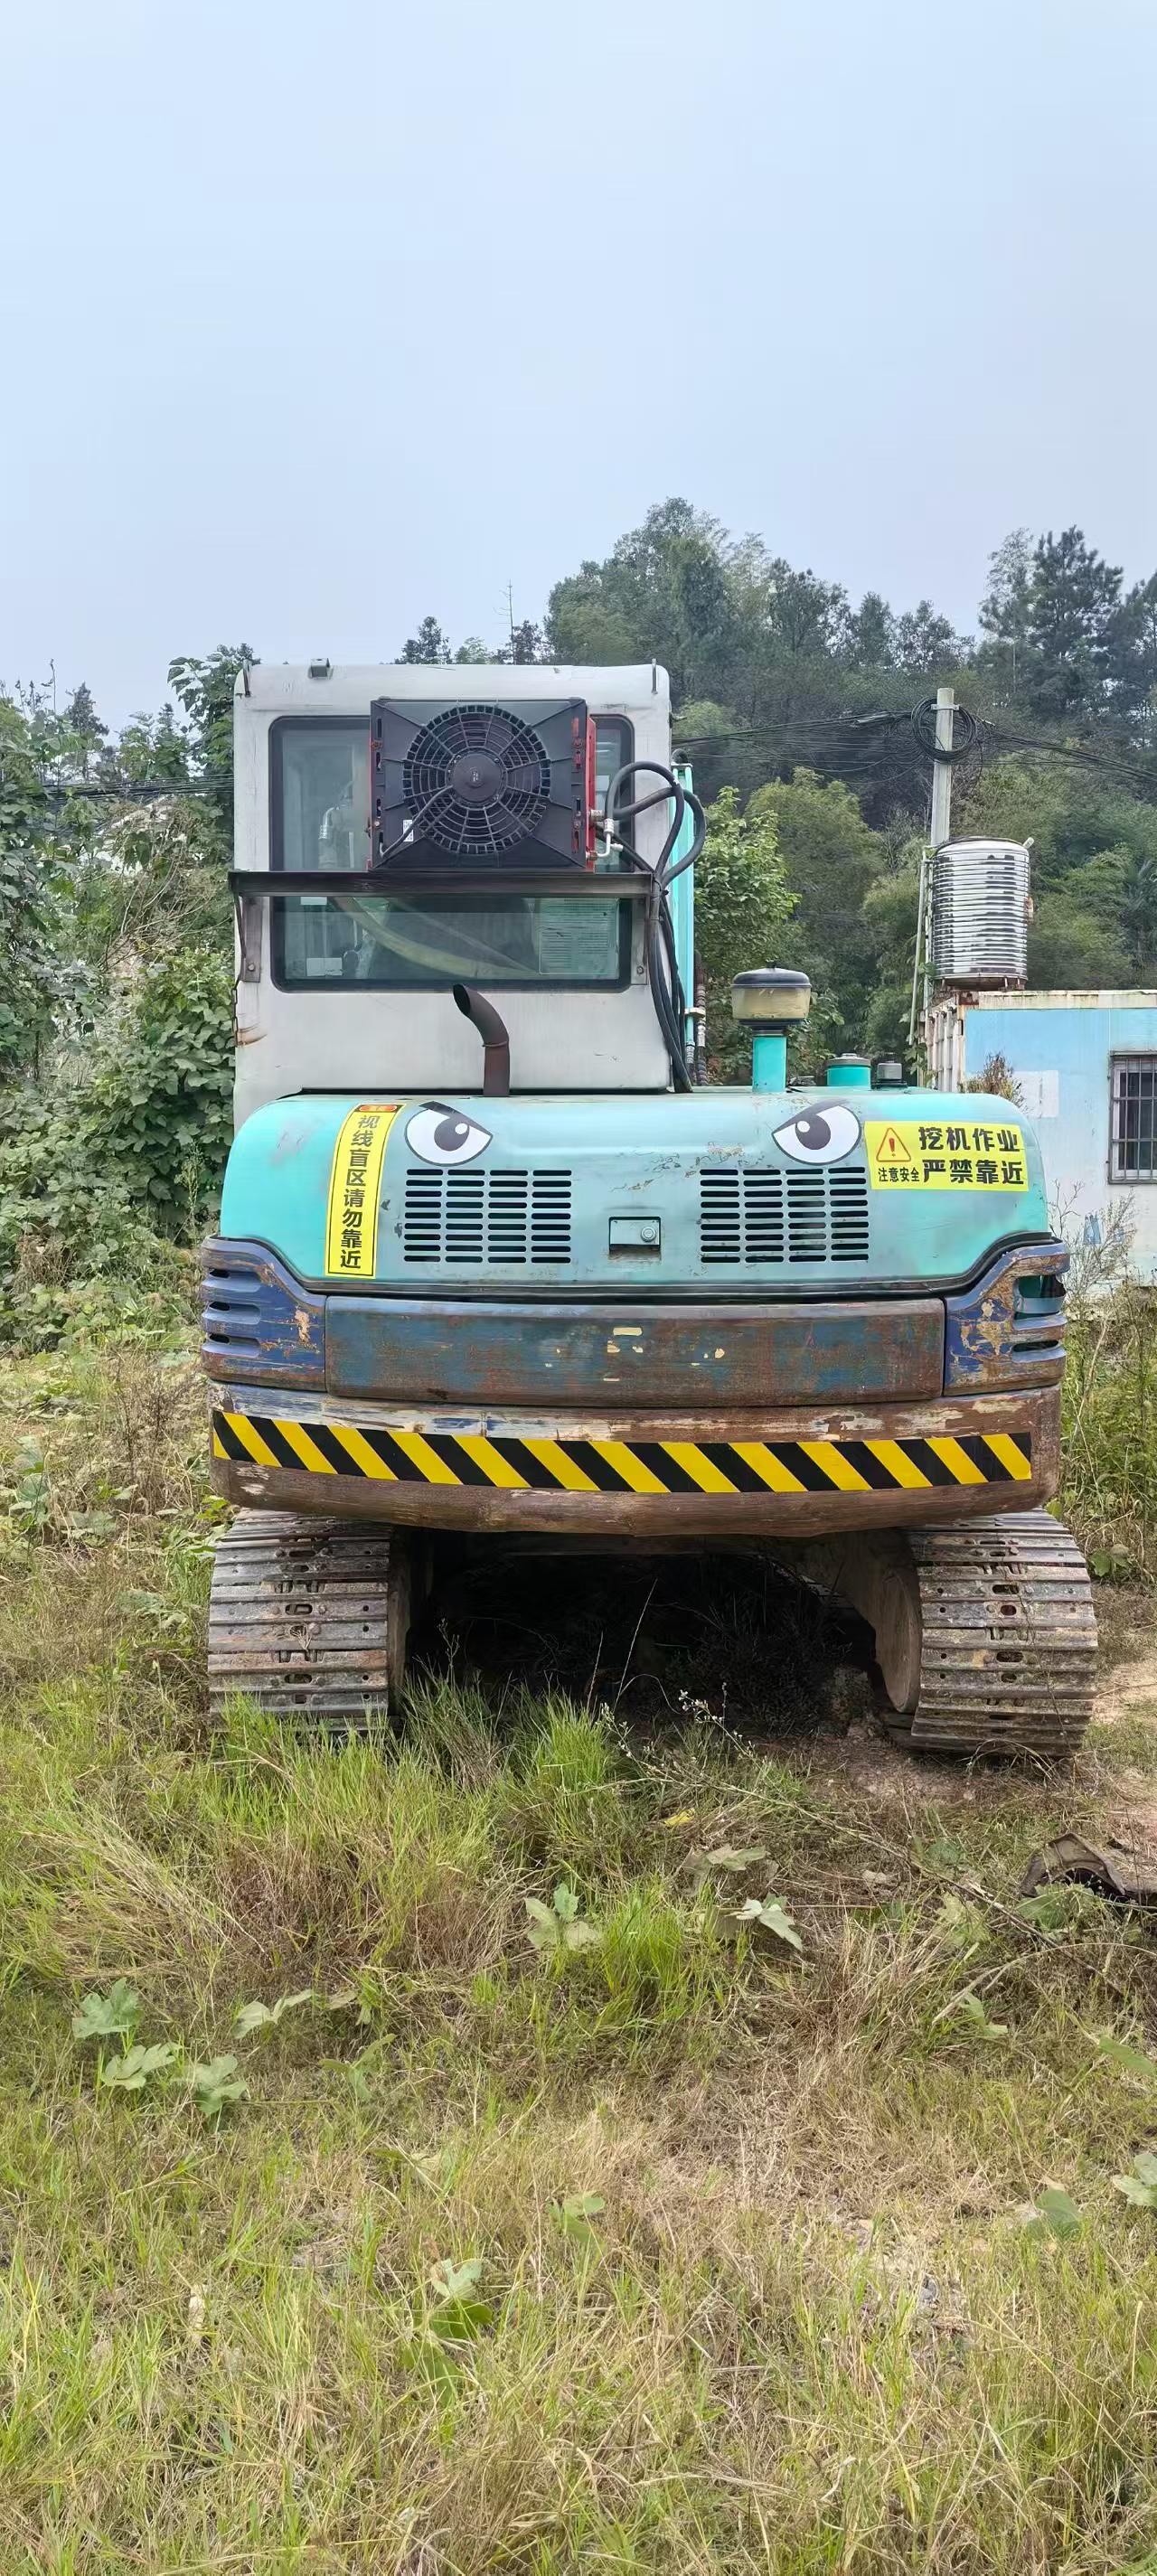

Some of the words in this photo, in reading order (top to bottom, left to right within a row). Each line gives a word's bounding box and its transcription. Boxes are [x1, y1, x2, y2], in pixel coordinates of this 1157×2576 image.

[918, 1126, 1020, 1152] 挖机作业
[878, 1166, 920, 1182] 注意安全
[922, 1159, 1024, 1185] 严禁靠近
[340, 1114, 380, 1269] 视线盲区请勿靠近
